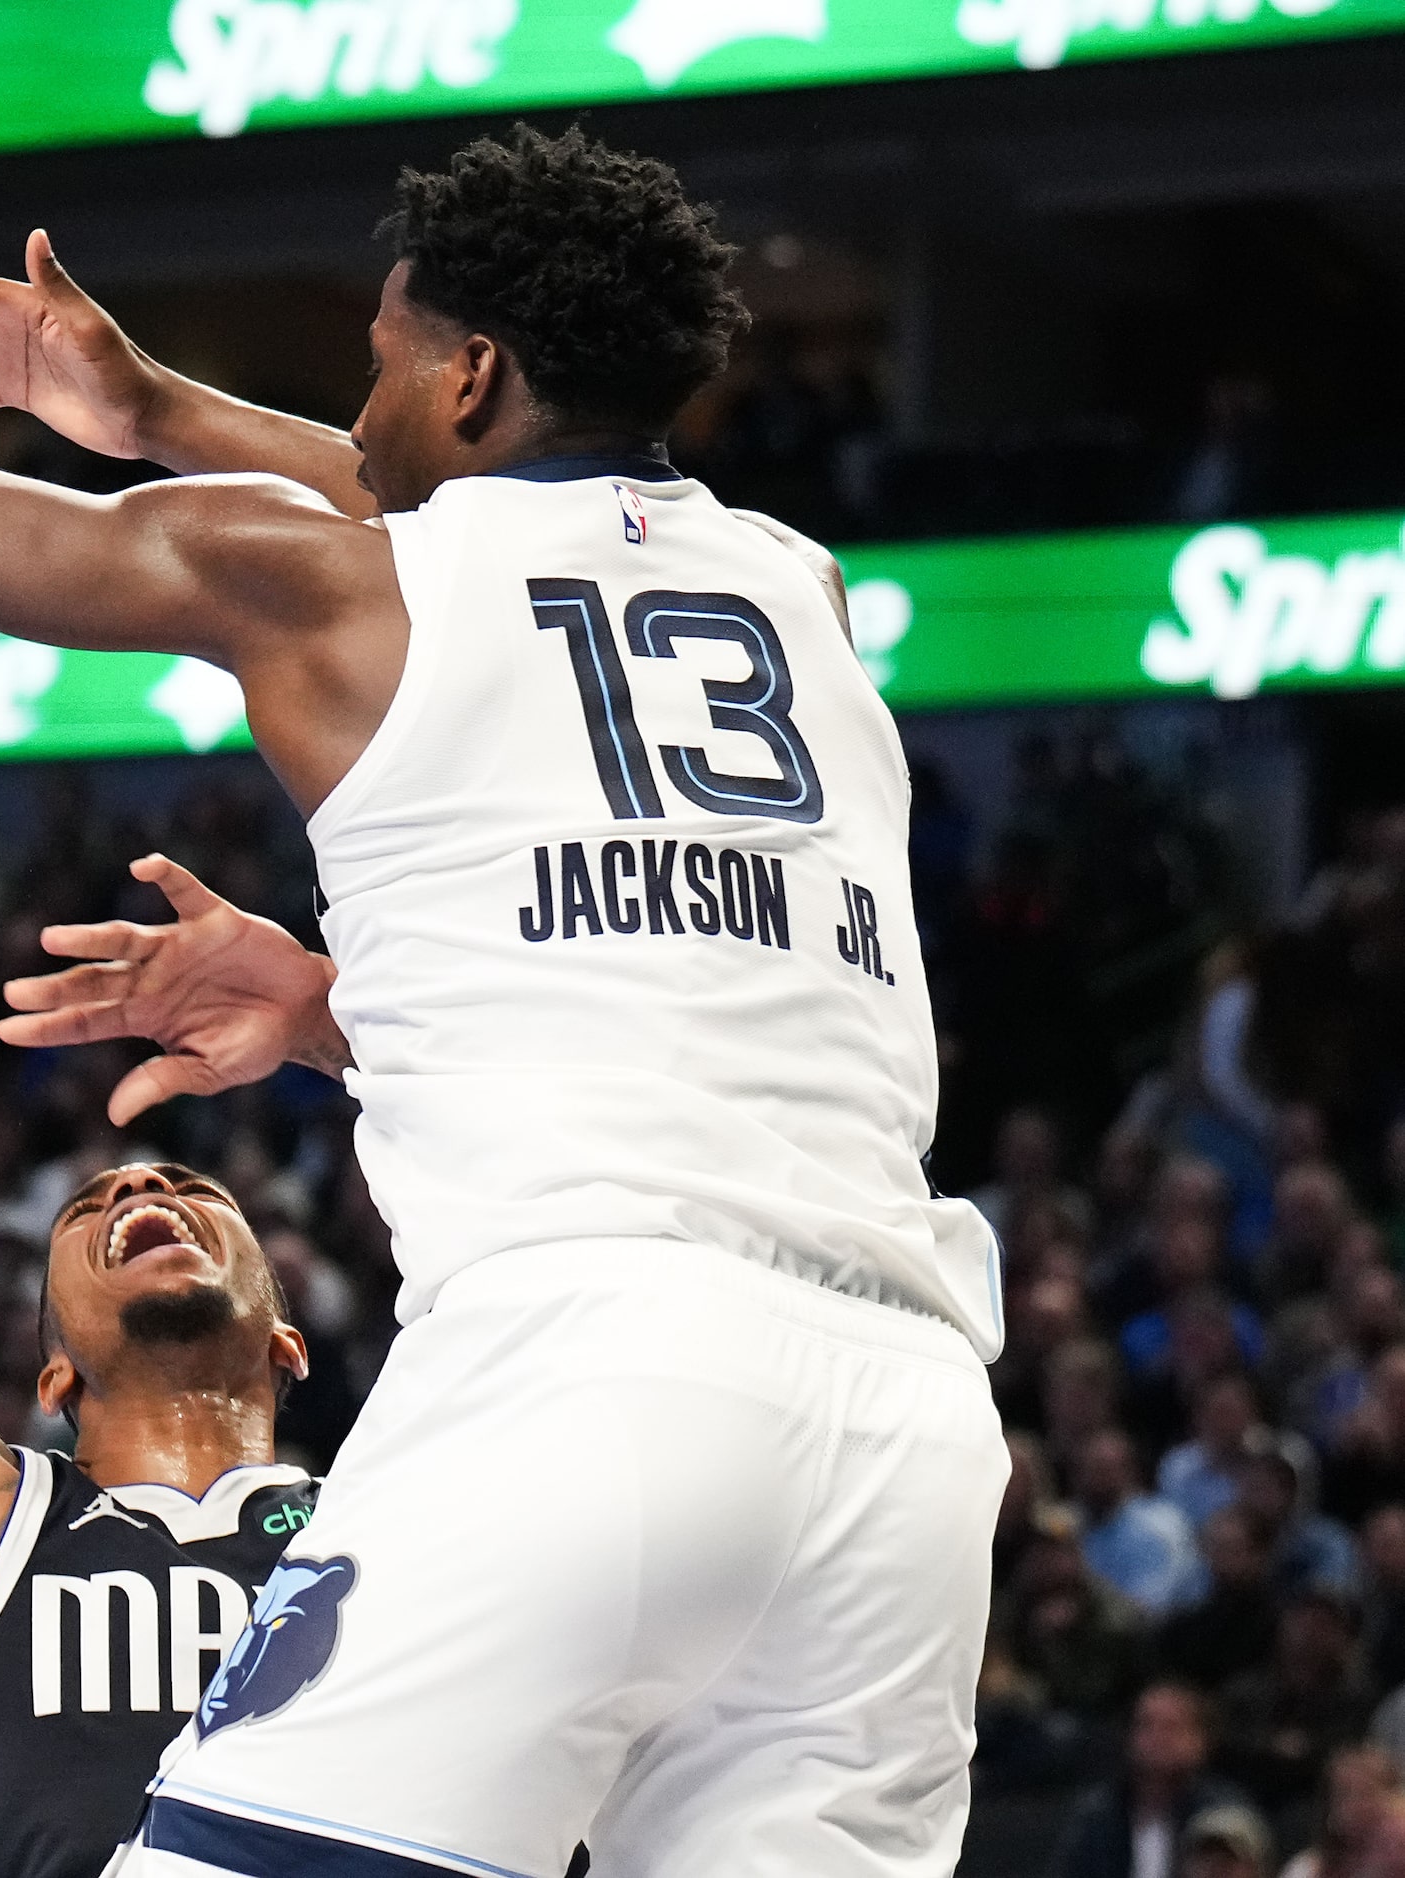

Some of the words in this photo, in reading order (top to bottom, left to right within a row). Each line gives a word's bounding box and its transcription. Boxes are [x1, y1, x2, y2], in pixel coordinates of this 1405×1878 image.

[144, 0, 520, 136] Sprite
[525, 577, 824, 824] 13
[519, 839, 791, 951] JACKSON
[836, 876, 895, 987] JR.
[32, 1565, 264, 1717] MA
